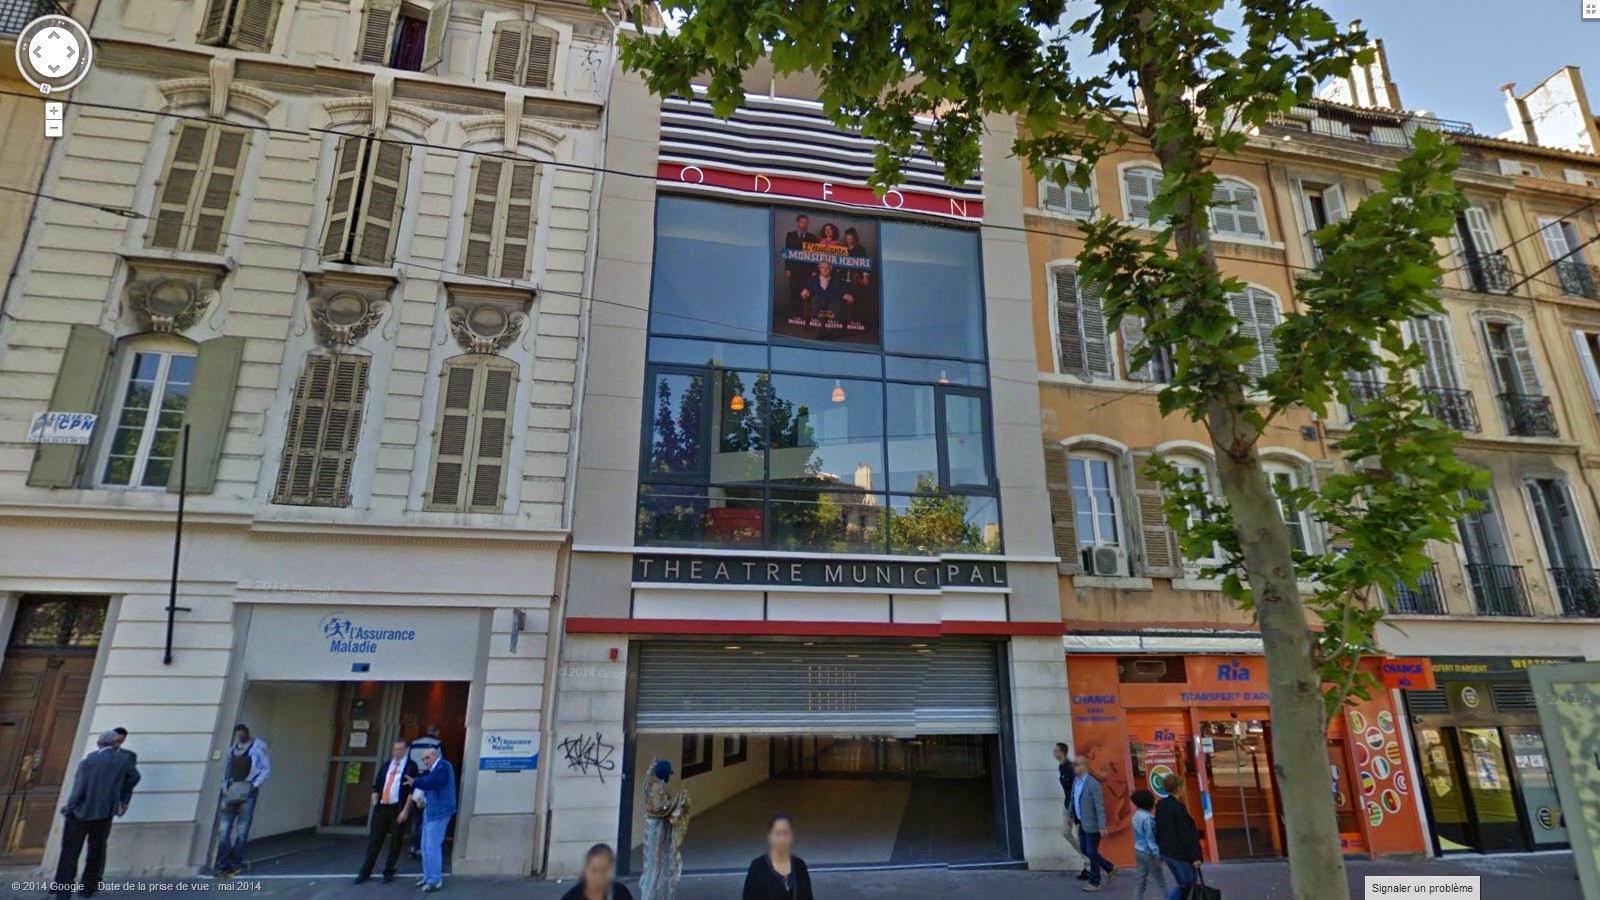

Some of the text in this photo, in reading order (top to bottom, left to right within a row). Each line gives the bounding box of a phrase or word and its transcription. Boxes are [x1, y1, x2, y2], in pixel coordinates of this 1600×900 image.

[788, 250, 838, 265] MONSIEUR
[839, 256, 871, 268] HENRI
[639, 559, 1005, 585] THEATRE MUNICIPAL
[350, 626, 415, 641] l'Assurance
[330, 639, 377, 653] Maladie
[1217, 659, 1250, 681] Ria
[1073, 694, 1117, 704] CHANGE
[1180, 692, 1241, 702] TRANSFERT
[1154, 727, 1176, 741] Ria
